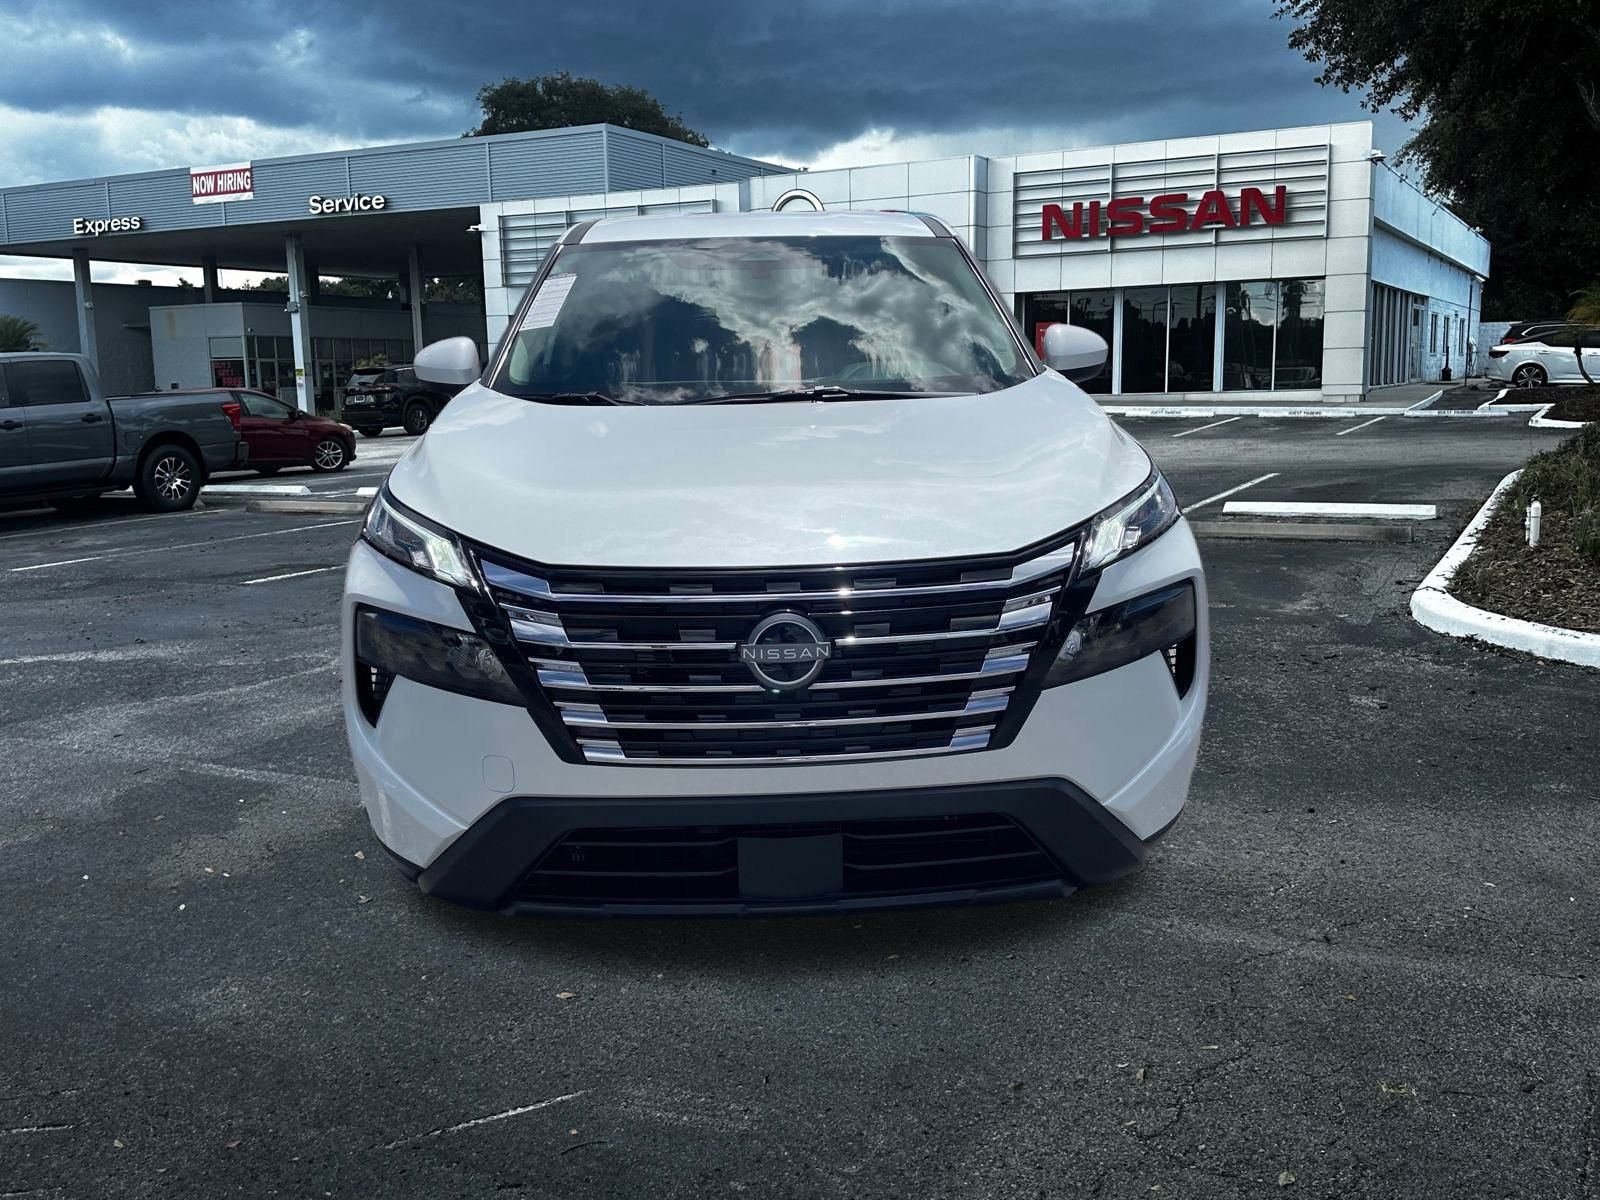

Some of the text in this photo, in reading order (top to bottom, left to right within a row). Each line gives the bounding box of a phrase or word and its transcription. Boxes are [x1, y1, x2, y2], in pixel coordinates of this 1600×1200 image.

[192, 171, 251, 195] NOW HIRING
[309, 193, 385, 214] Service
[1042, 185, 1287, 241] NISSAN
[73, 216, 141, 236] Express
[743, 646, 829, 659] NISSAN
